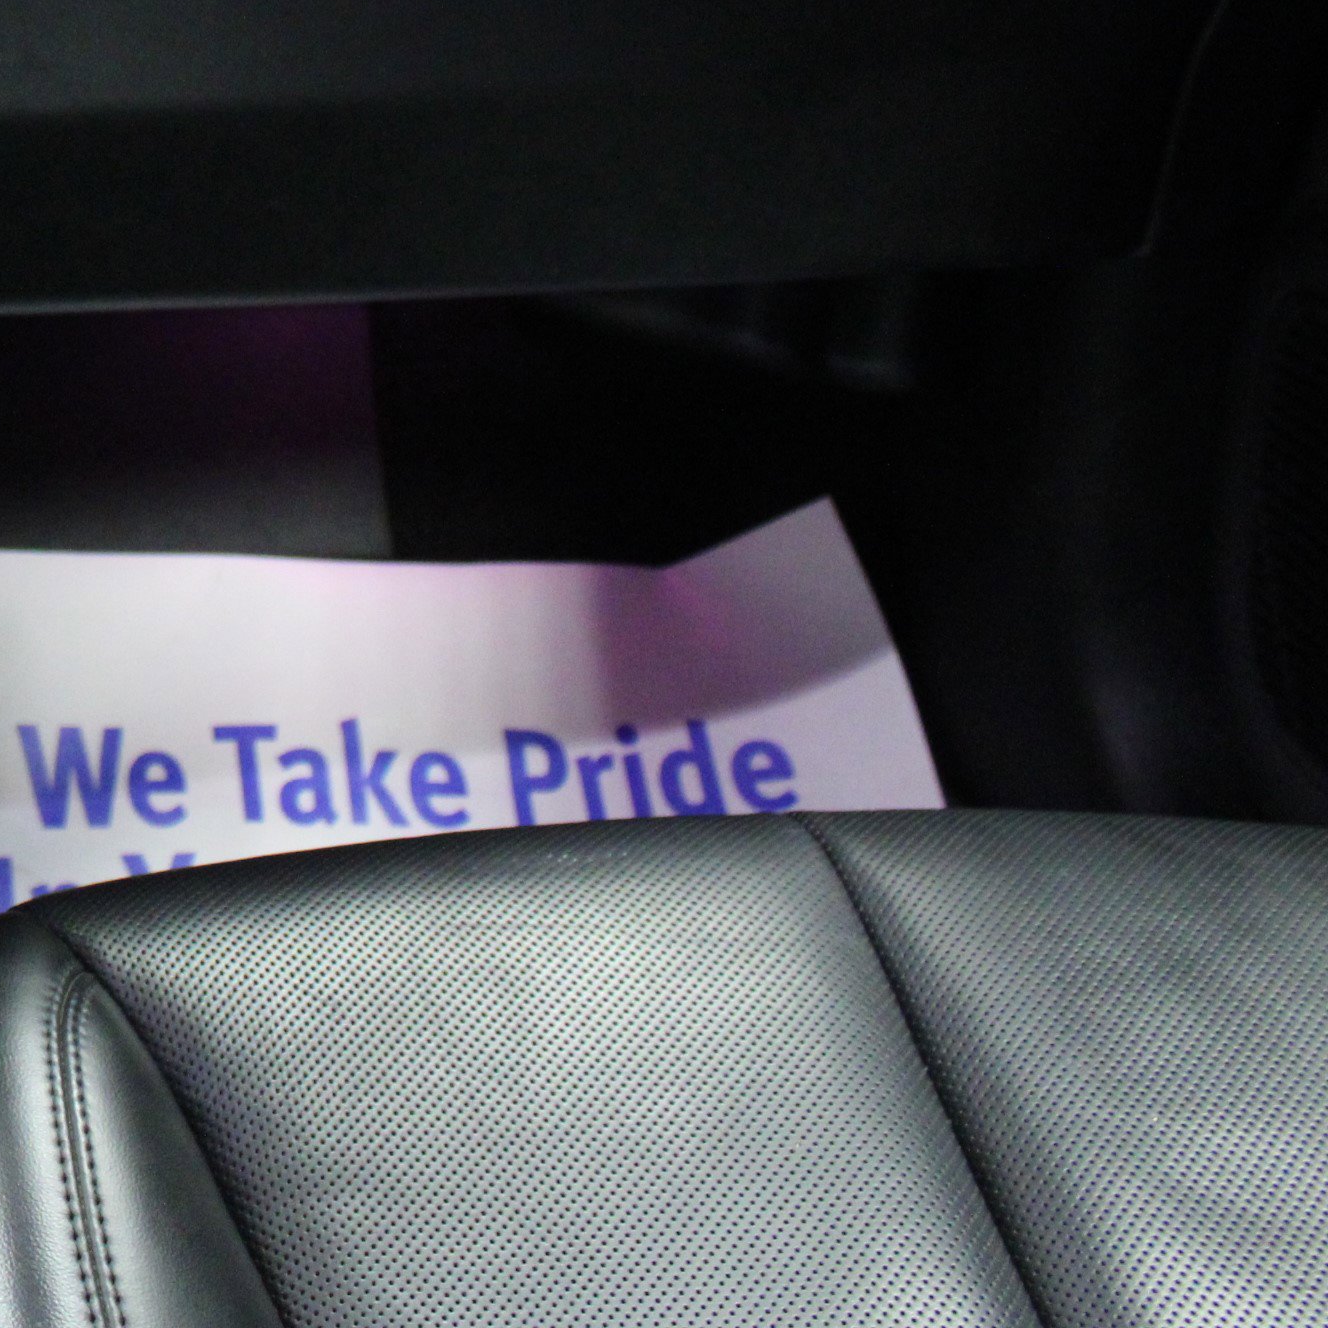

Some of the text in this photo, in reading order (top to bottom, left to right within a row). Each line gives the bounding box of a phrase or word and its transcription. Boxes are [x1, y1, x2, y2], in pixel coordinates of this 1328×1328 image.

[15, 717, 800, 830] We Take Pride
